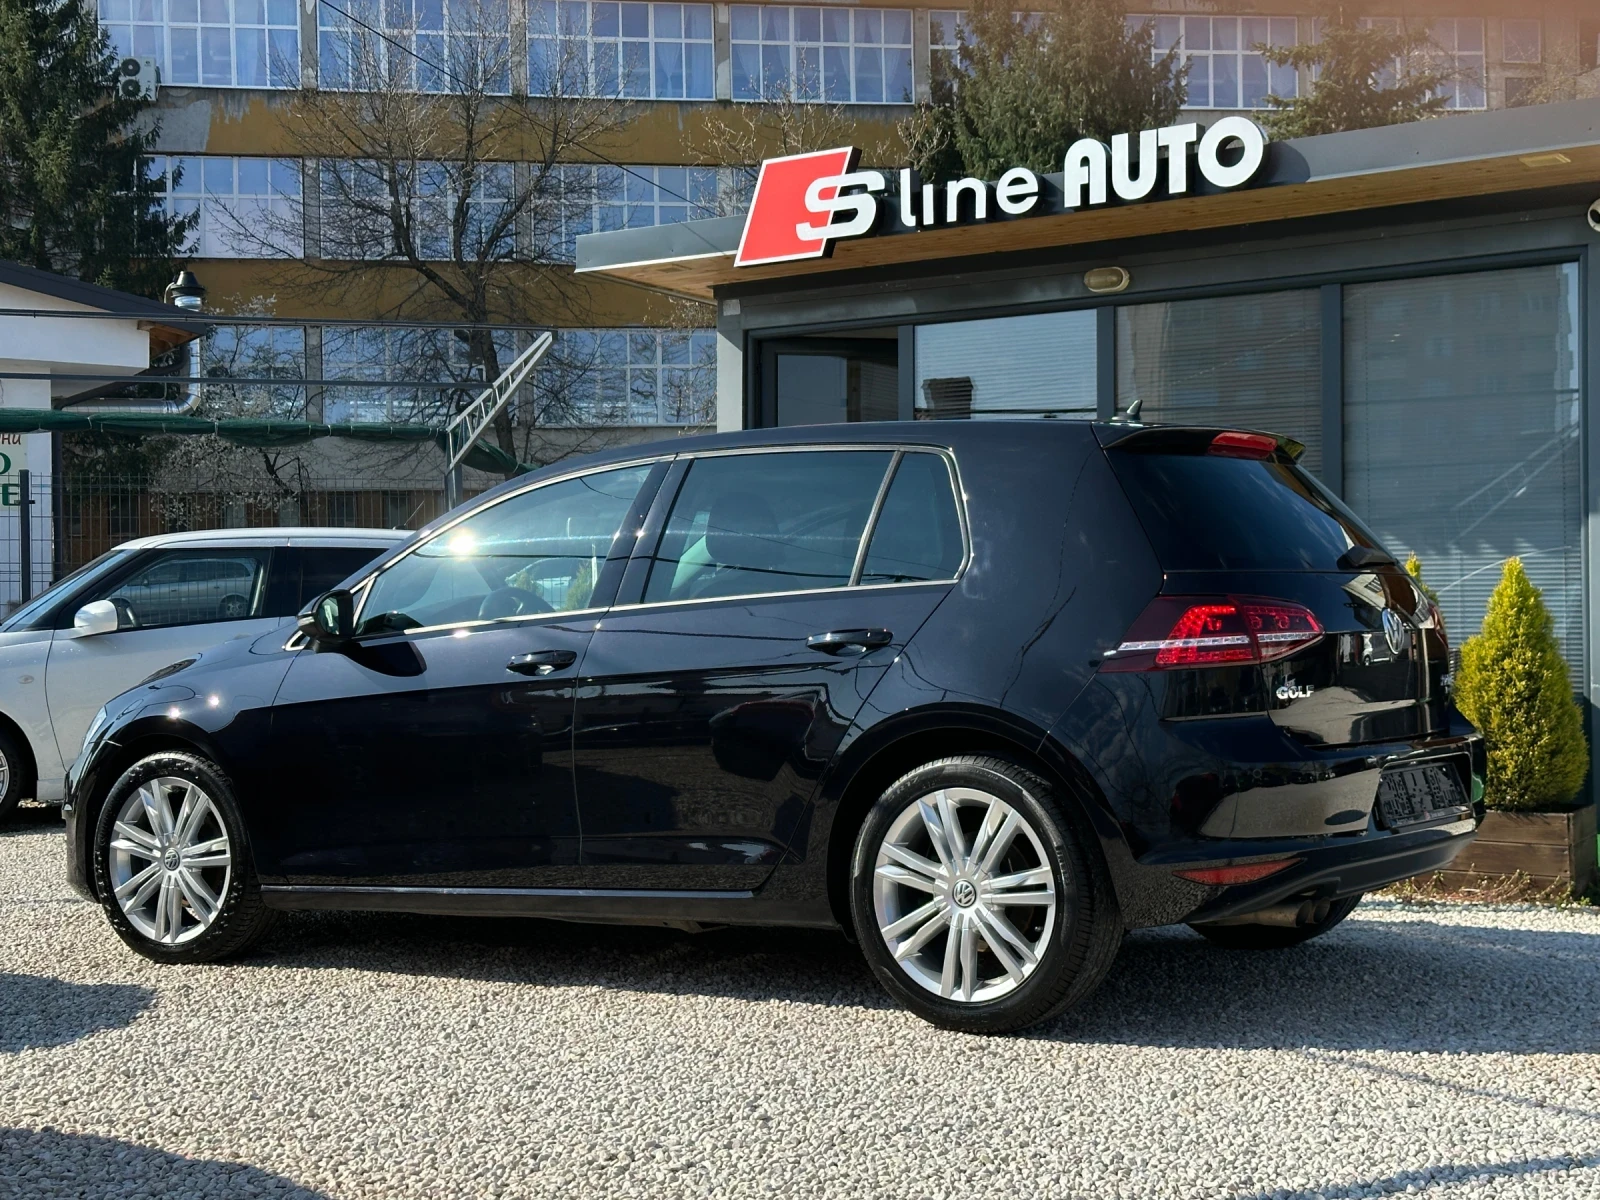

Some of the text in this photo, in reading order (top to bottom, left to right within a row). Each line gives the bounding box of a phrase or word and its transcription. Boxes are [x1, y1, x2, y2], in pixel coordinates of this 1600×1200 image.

[795, 115, 1265, 241] S line AUTO
[1276, 685, 1314, 699] GOLF
